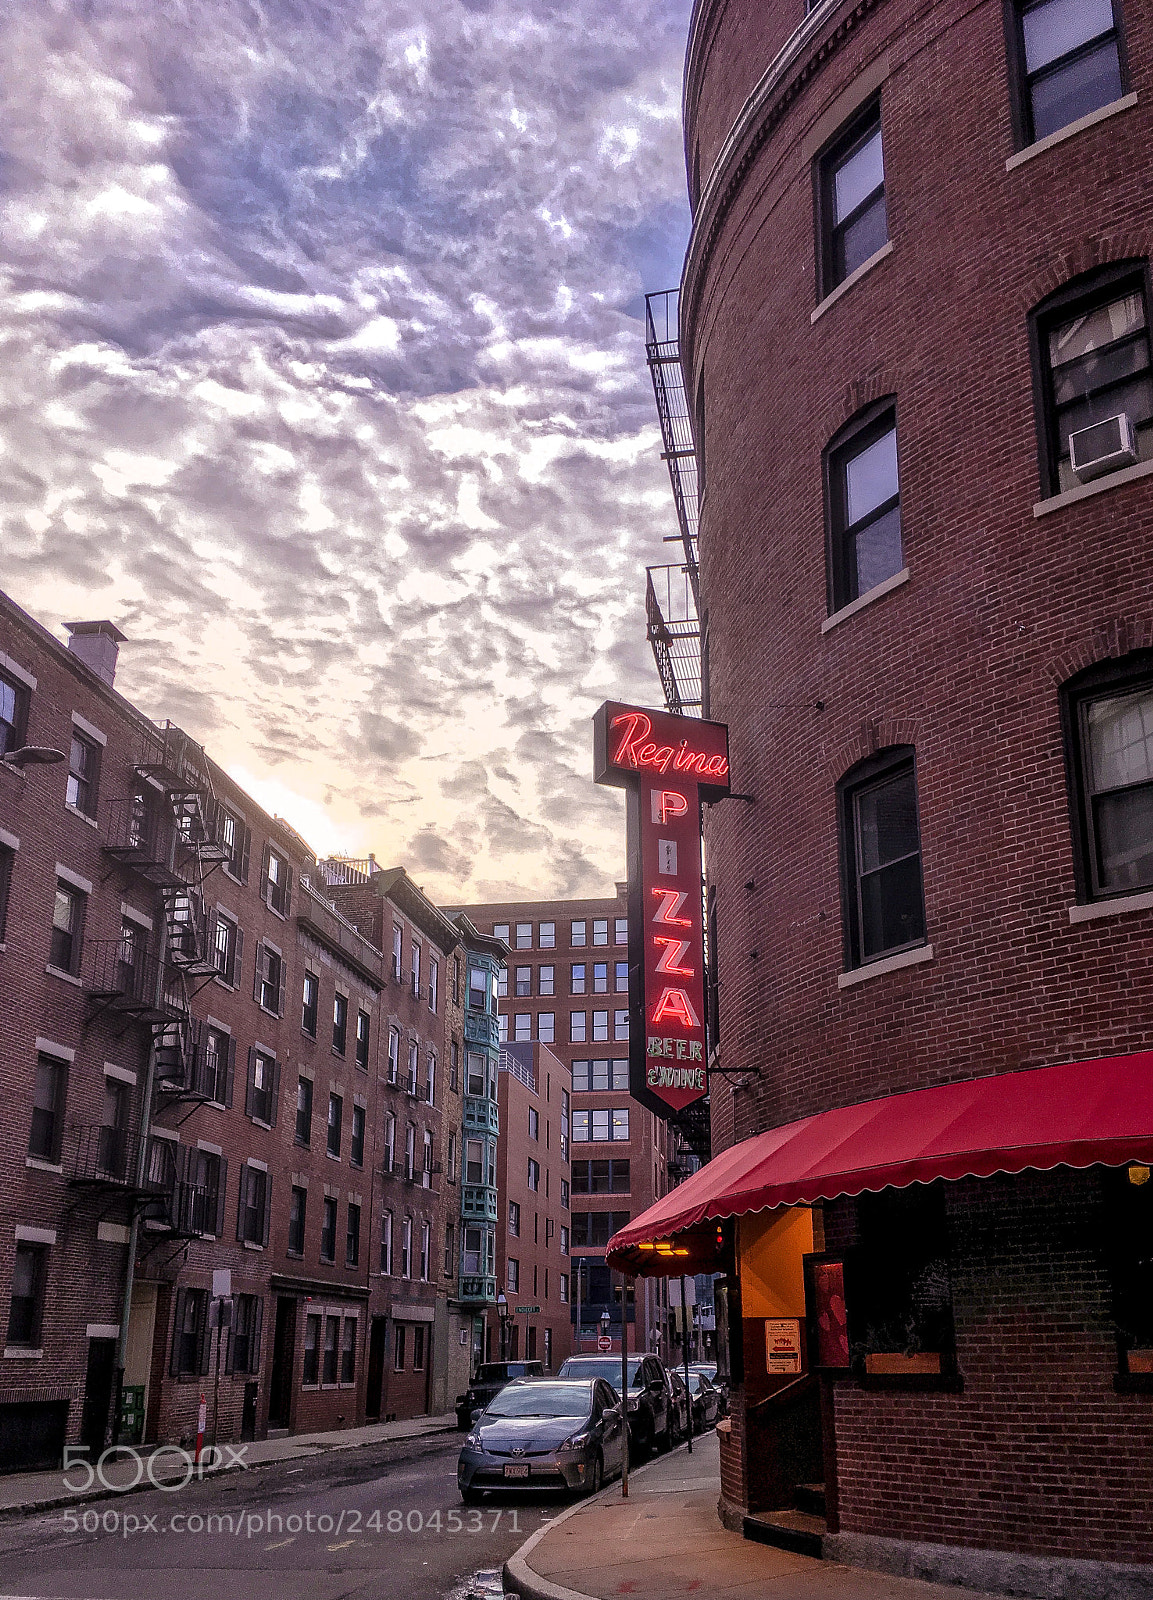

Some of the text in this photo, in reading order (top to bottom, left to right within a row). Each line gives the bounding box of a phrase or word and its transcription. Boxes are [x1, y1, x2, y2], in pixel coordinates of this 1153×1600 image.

[610, 712, 729, 776] Regina
[651, 789, 700, 1027] PIZZA
[647, 1036, 702, 1061] BEER
